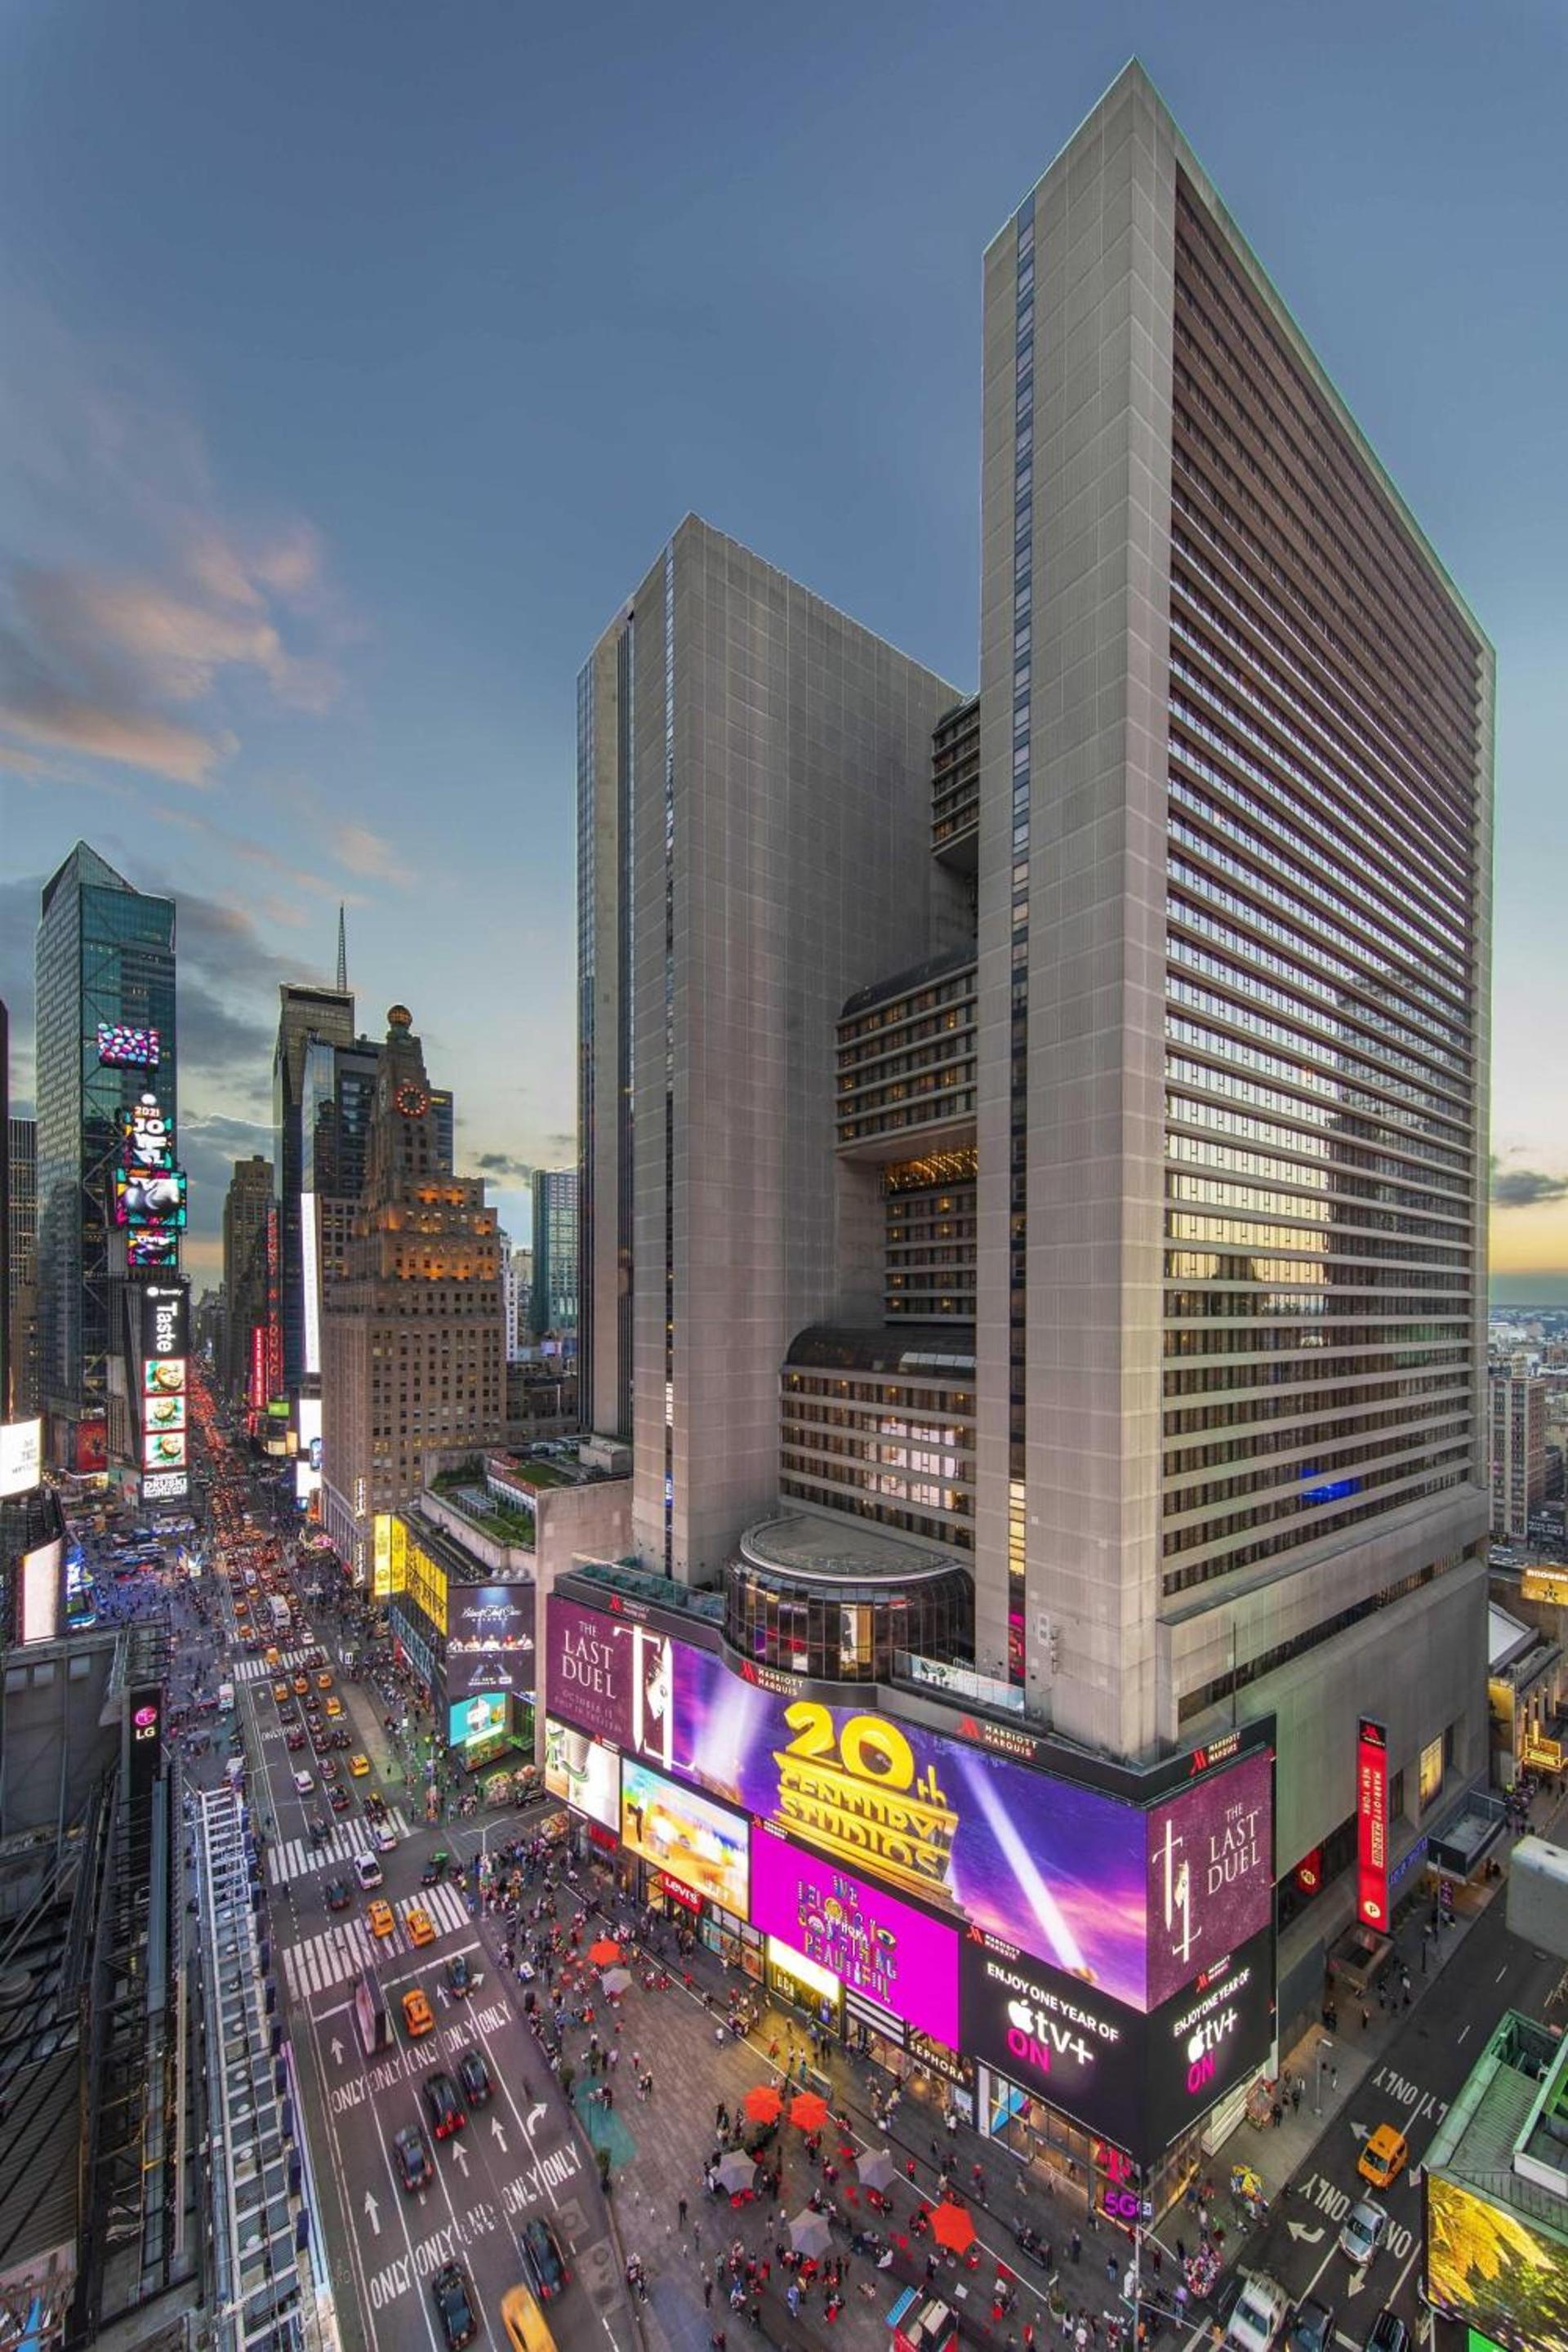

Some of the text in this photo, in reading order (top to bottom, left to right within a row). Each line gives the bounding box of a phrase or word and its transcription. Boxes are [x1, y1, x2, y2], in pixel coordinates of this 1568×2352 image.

[156, 1302, 178, 1352] Taste
[578, 1620, 596, 1637] THE
[564, 1629, 614, 1670] LAST
[562, 1654, 617, 1699] DUEL
[758, 1668, 804, 1688] MARRIOTT
[758, 1677, 798, 1696] MARQUIS
[136, 1726, 156, 1740] LG
[985, 1724, 1038, 1748] MARRIOTT
[985, 1735, 1032, 1757] MARQUIS
[1226, 1802, 1243, 1823] THE
[1209, 1807, 1260, 1864] LAST
[1208, 1840, 1261, 1895] DUEL
[987, 1962, 1120, 2042] ENJOY ONE YEAR OF
[1174, 1968, 1250, 2038] ENJOY ONE YEAR OF
[332, 2074, 366, 2114] ONLY
[368, 2056, 403, 2092] ONLY
[442, 2019, 479, 2053] ONLY
[478, 2000, 512, 2034] ONLY
[910, 2040, 964, 2082] SEPHORA
[1006, 2027, 1050, 2074] ON
[1187, 2051, 1215, 2094] ON
[1372, 2067, 1419, 2105] ONLY
[1422, 2096, 1449, 2126] LY
[1105, 2189, 1137, 2218] 5G
[1298, 2173, 1351, 2222] ONLY
[370, 2255, 412, 2310] ONLY
[415, 2225, 457, 2276] ONLY
[502, 2167, 544, 2214] ONLY
[542, 2143, 582, 2187] ONLY
[1385, 2221, 1413, 2259] ON
